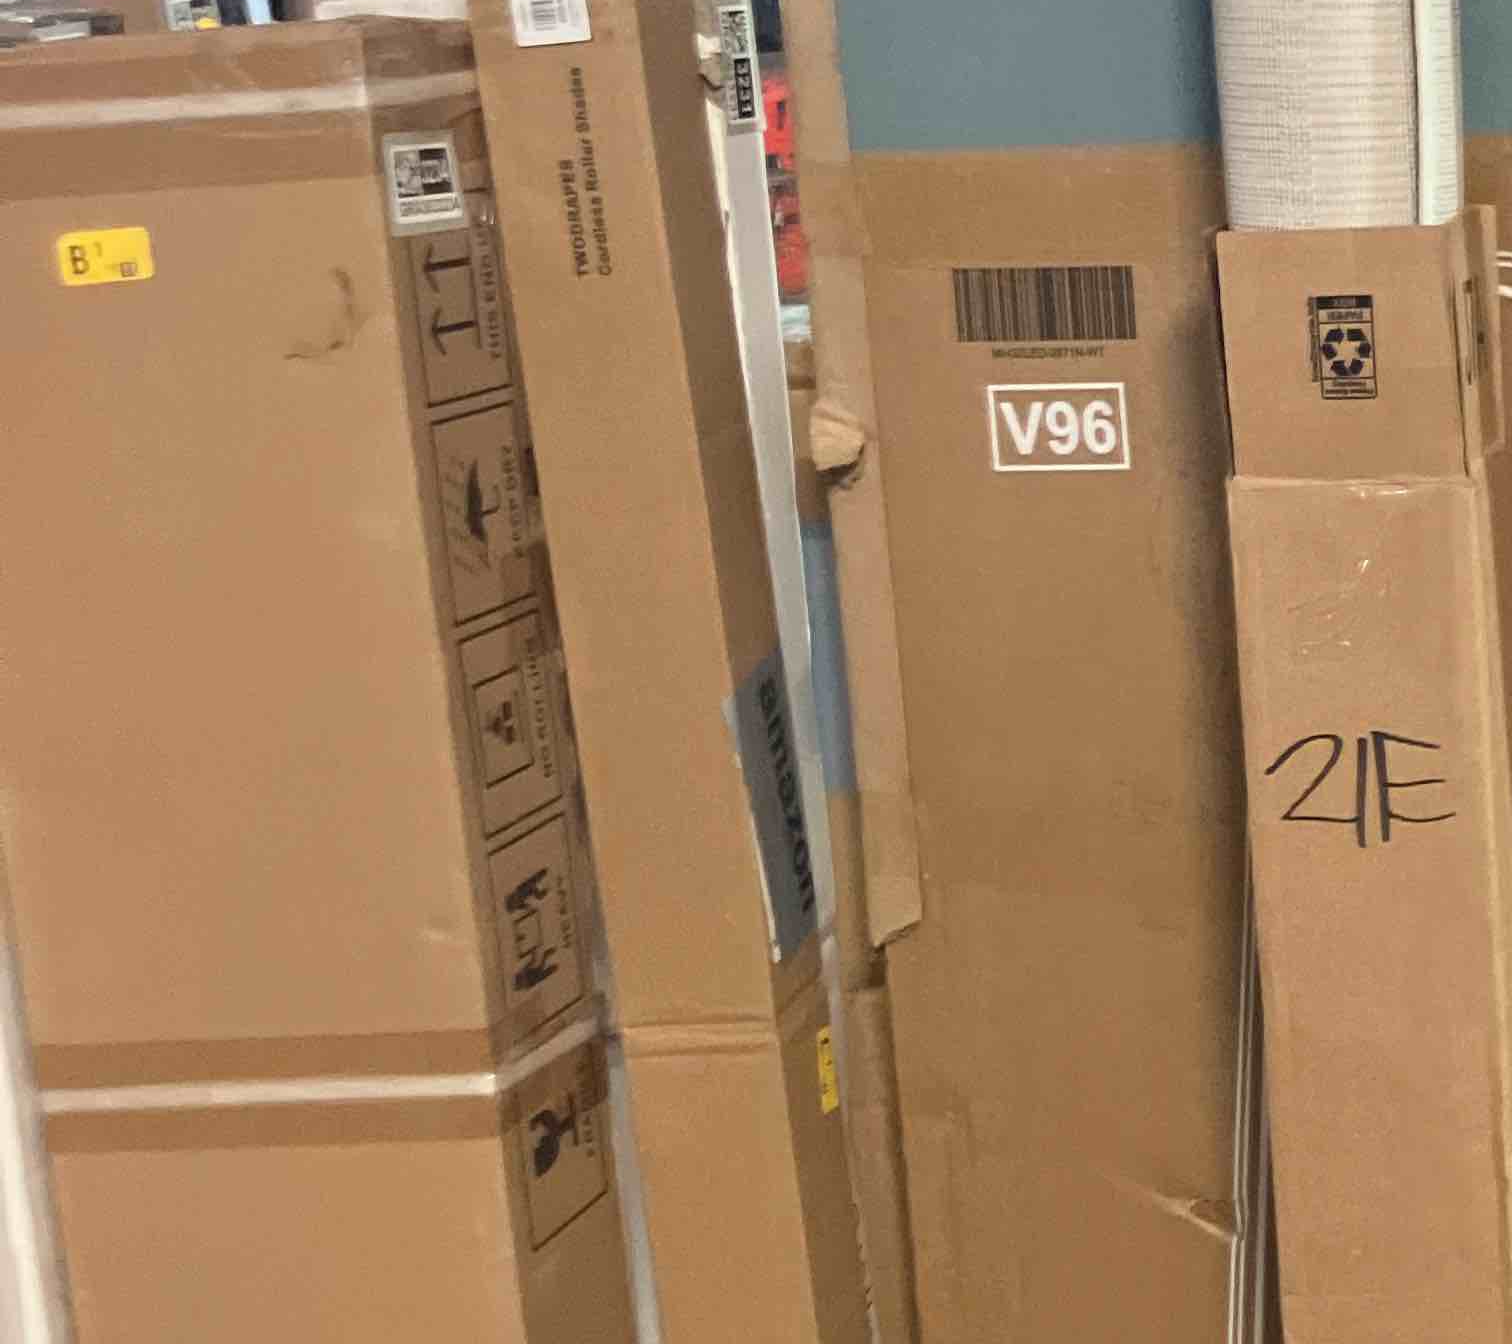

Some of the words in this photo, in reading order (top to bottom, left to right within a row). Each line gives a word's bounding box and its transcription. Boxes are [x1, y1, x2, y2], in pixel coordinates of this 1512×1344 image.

[568, 67, 591, 133] Shades
[581, 138, 599, 192] Roller
[1000, 399, 1117, 455] V96
[759, 675, 816, 915] amazon
